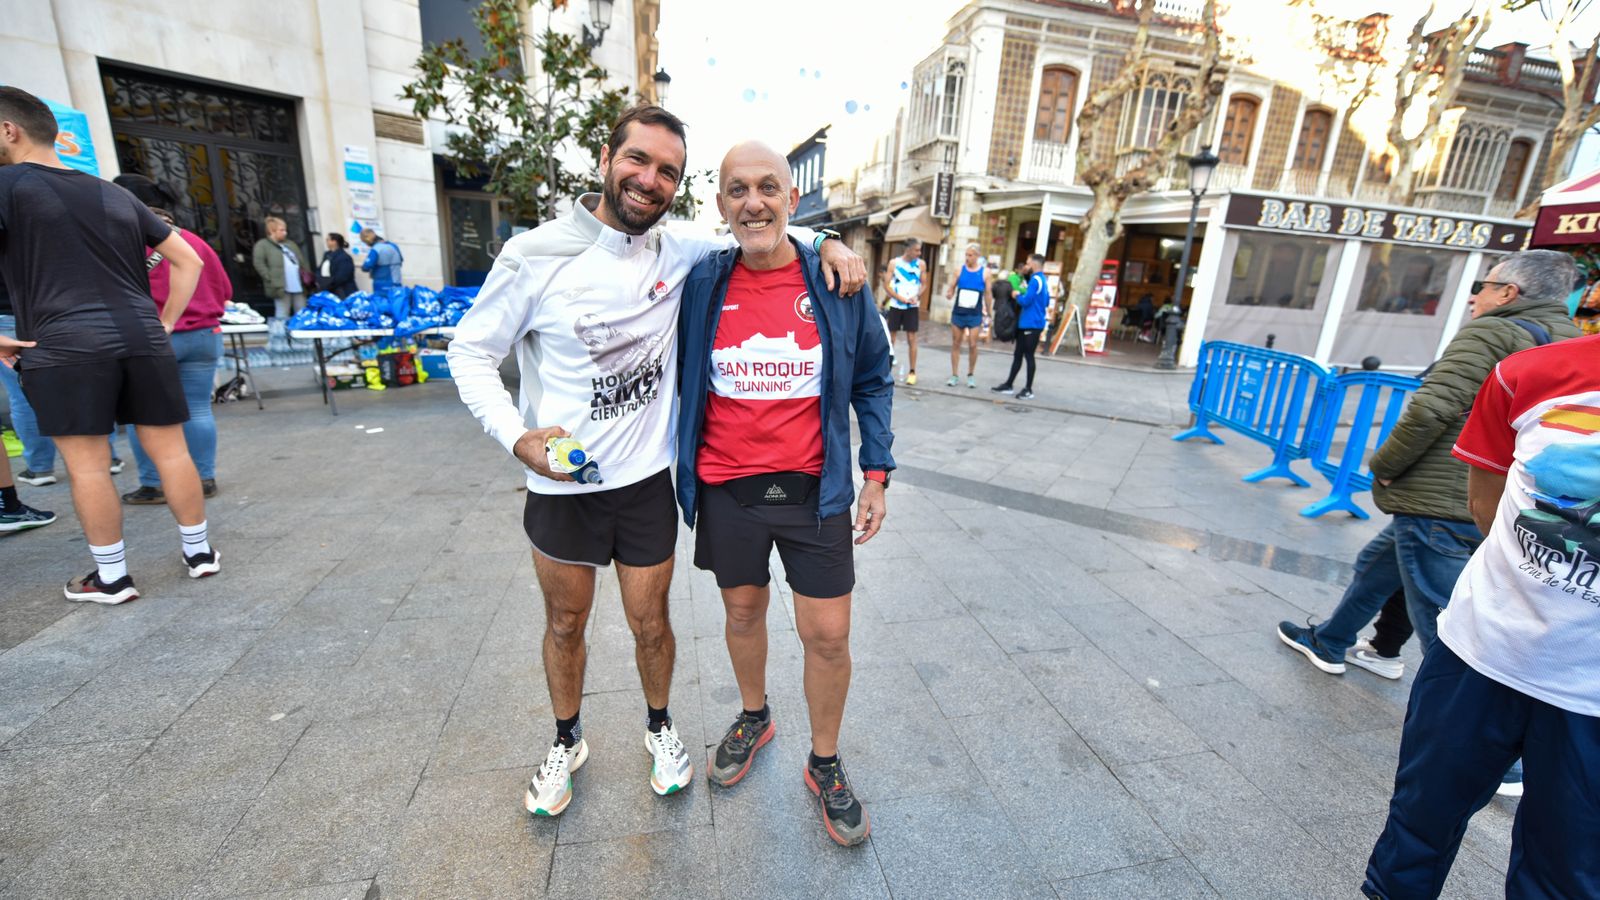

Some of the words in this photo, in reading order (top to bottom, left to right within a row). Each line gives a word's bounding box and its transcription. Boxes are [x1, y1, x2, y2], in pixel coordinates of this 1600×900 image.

[1258, 199, 1331, 232] BAR
[1338, 207, 1386, 238] DE
[1392, 213, 1493, 248] TAPAS
[1553, 212, 1600, 234] KI
[717, 362, 748, 376] SAN
[752, 361, 814, 378] ROQUE
[734, 380, 792, 392] RUNNING
[1514, 524, 1563, 575] Vive
[1562, 550, 1600, 589] la
[1542, 574, 1560, 587] de
[1561, 580, 1577, 595] la
[1581, 589, 1600, 608] Es
